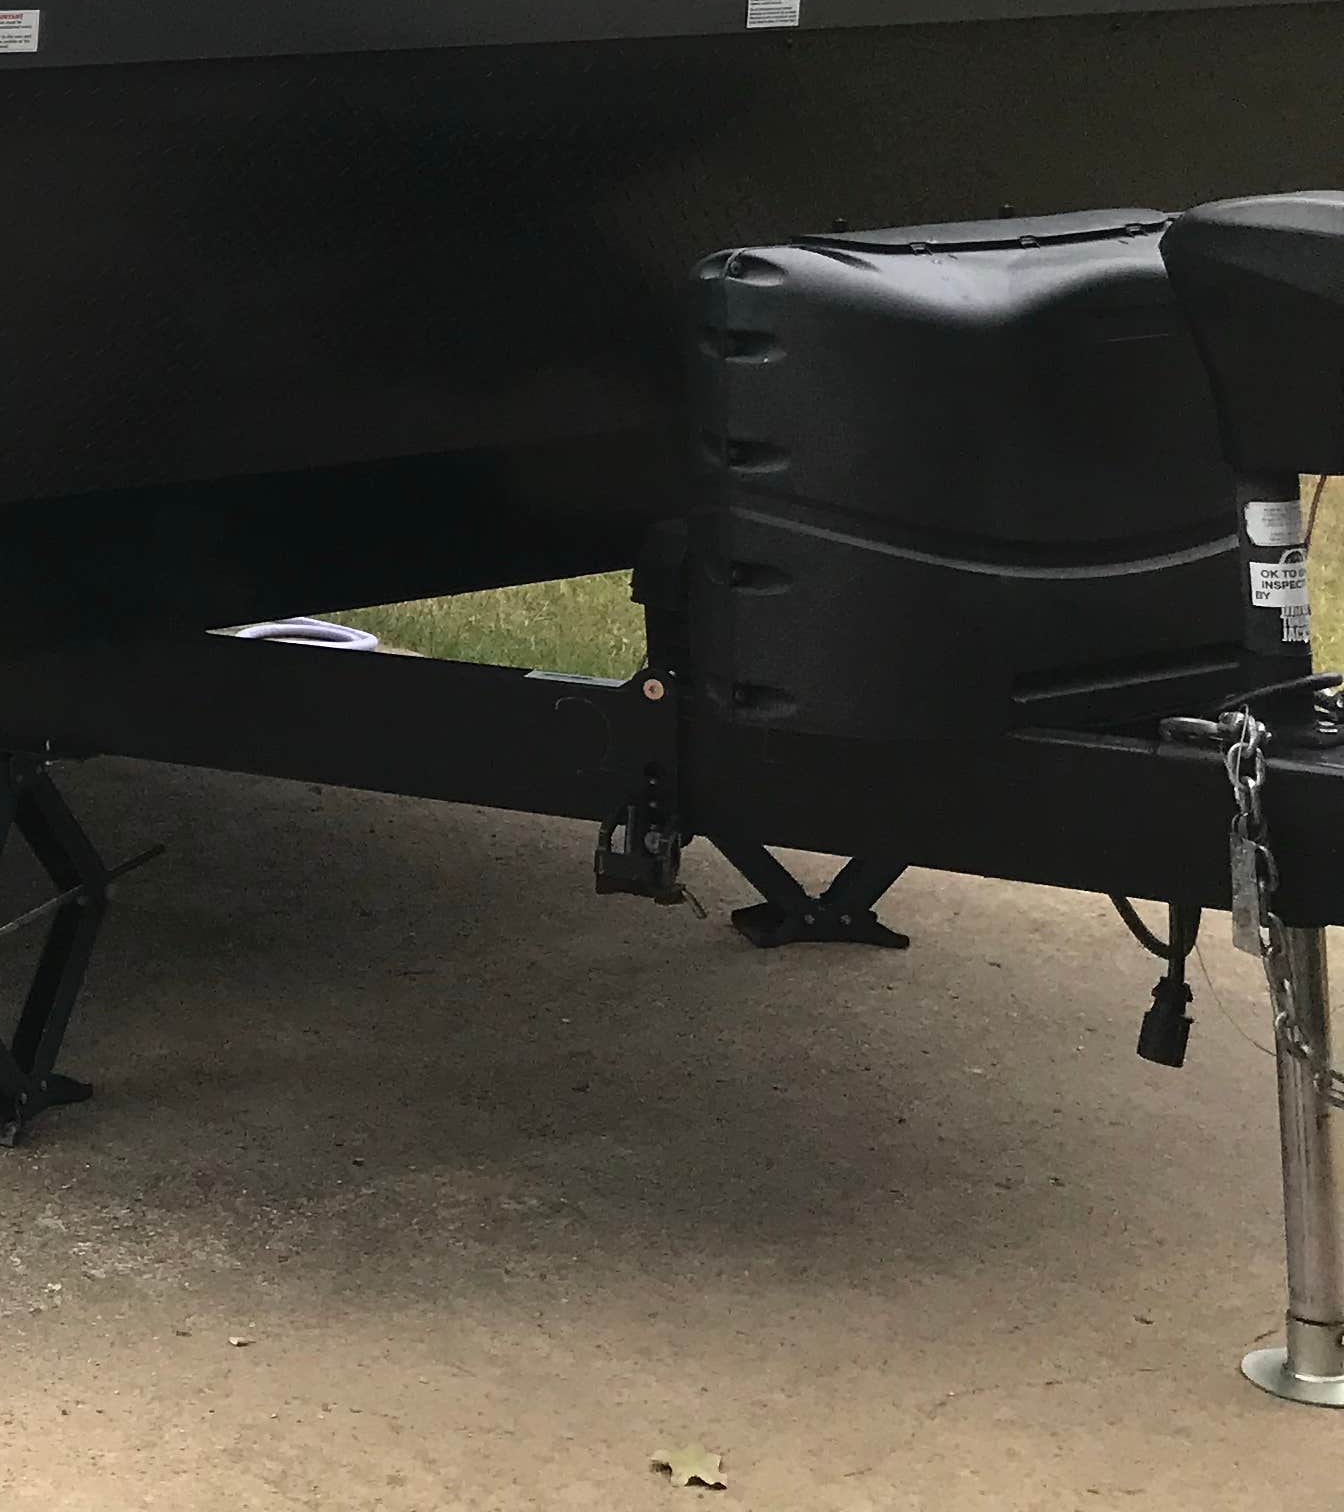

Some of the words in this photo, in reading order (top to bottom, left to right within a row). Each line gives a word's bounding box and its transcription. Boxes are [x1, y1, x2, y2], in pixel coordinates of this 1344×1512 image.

[1261, 569, 1279, 578] OK
[1282, 569, 1297, 578] TO
[1255, 591, 1271, 600] BY
